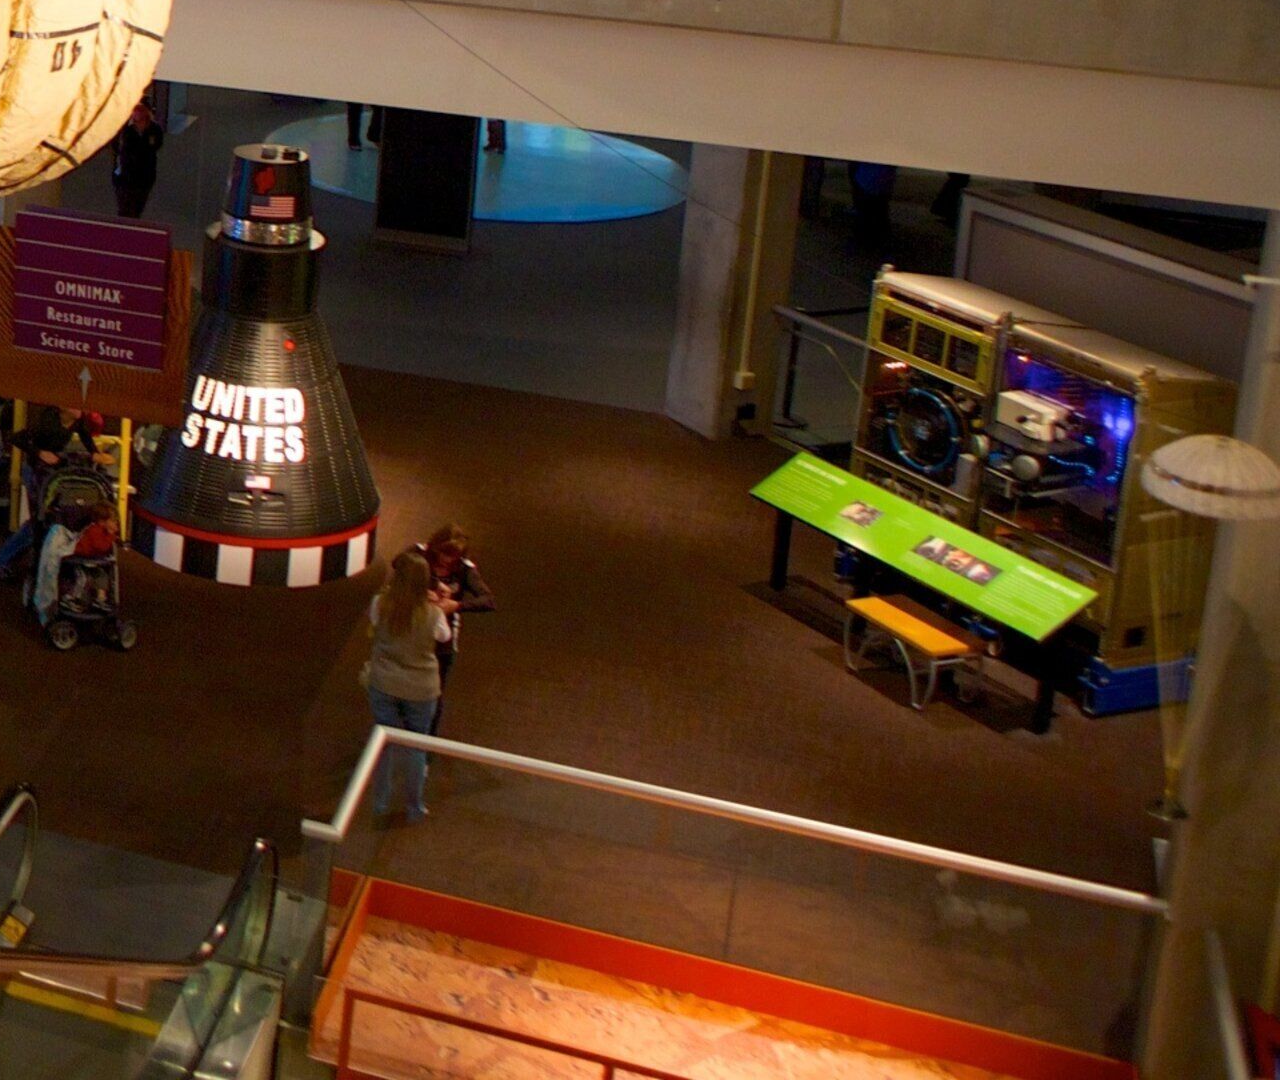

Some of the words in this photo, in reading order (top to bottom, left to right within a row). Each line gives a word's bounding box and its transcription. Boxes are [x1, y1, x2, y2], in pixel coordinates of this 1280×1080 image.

[55, 280, 121, 304] OMNIMAX
[46, 306, 123, 332] Restaurant
[40, 332, 91, 353] Science
[98, 341, 135, 360] Store
[191, 374, 305, 424] UNITED
[181, 412, 305, 463] STATES
